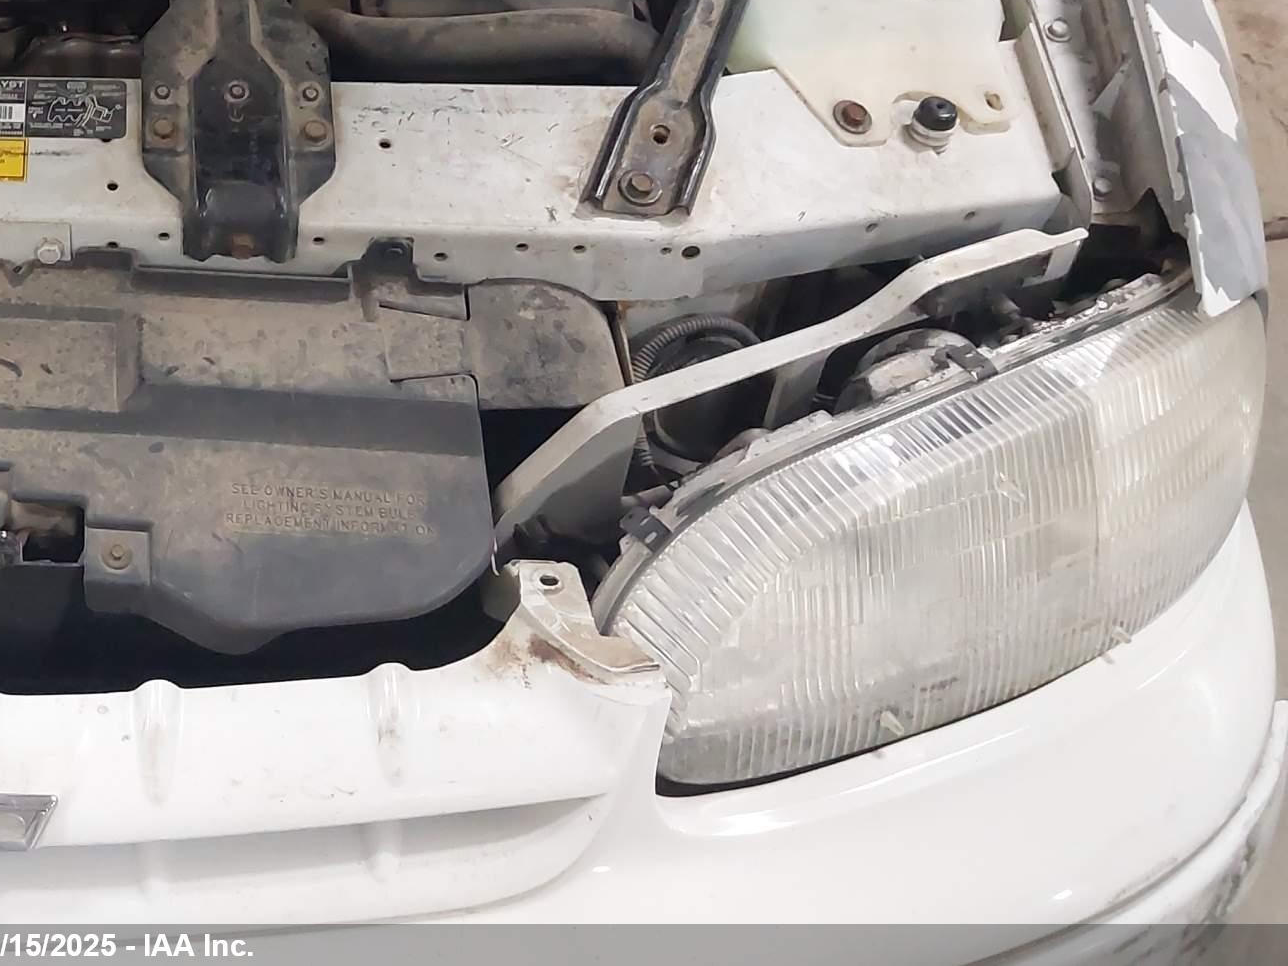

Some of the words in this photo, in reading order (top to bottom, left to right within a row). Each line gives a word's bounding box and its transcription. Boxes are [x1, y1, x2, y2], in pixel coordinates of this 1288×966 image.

[231, 482, 258, 495] SEE
[332, 489, 391, 503] MANUAL
[242, 499, 309, 516] LIGHTING
[225, 513, 330, 530] REPLACEMENT
